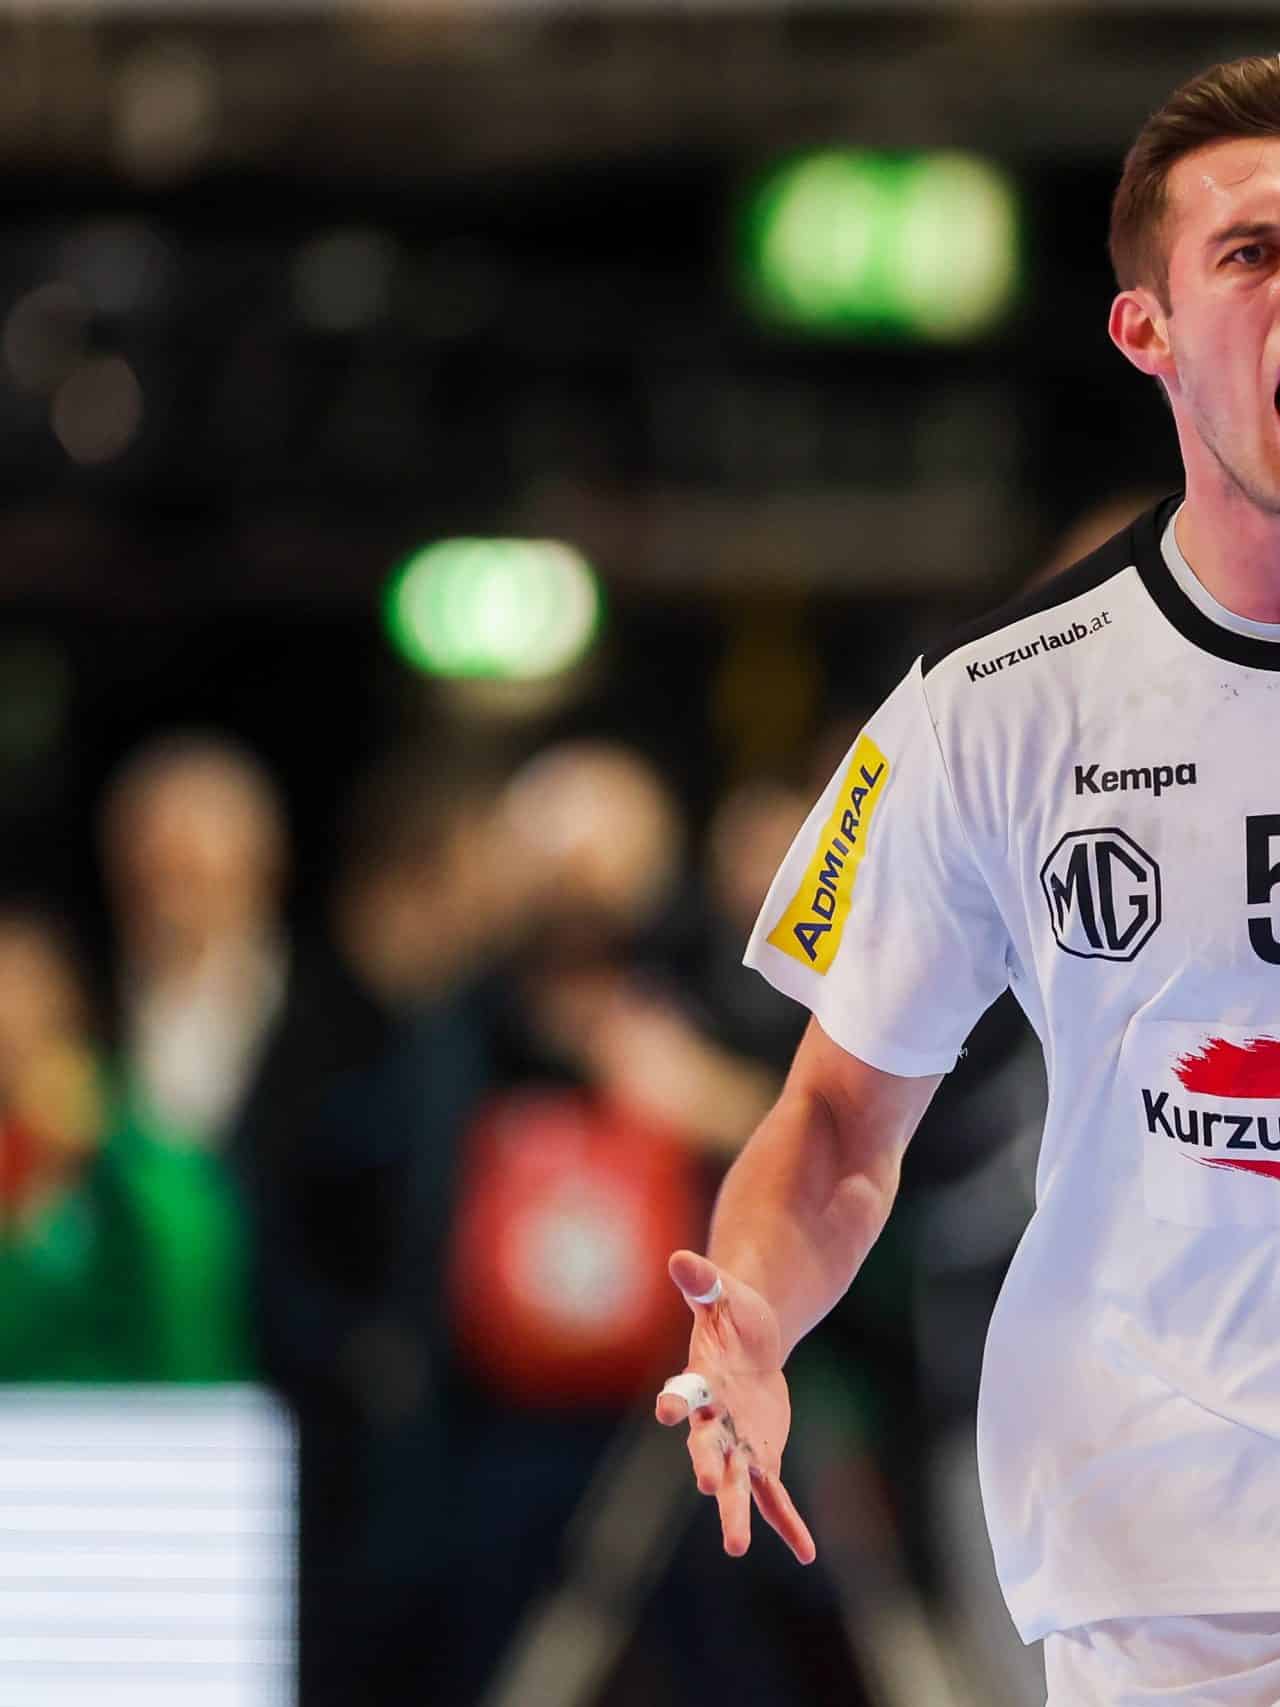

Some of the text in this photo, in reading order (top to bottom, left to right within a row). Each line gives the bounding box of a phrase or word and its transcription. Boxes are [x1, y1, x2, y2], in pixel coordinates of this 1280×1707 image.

[965, 611, 1112, 683] Kurzurlaub.at
[1074, 763, 1198, 797] Kempa
[793, 761, 885, 962] ADMIRAL
[1050, 841, 1148, 950] MG
